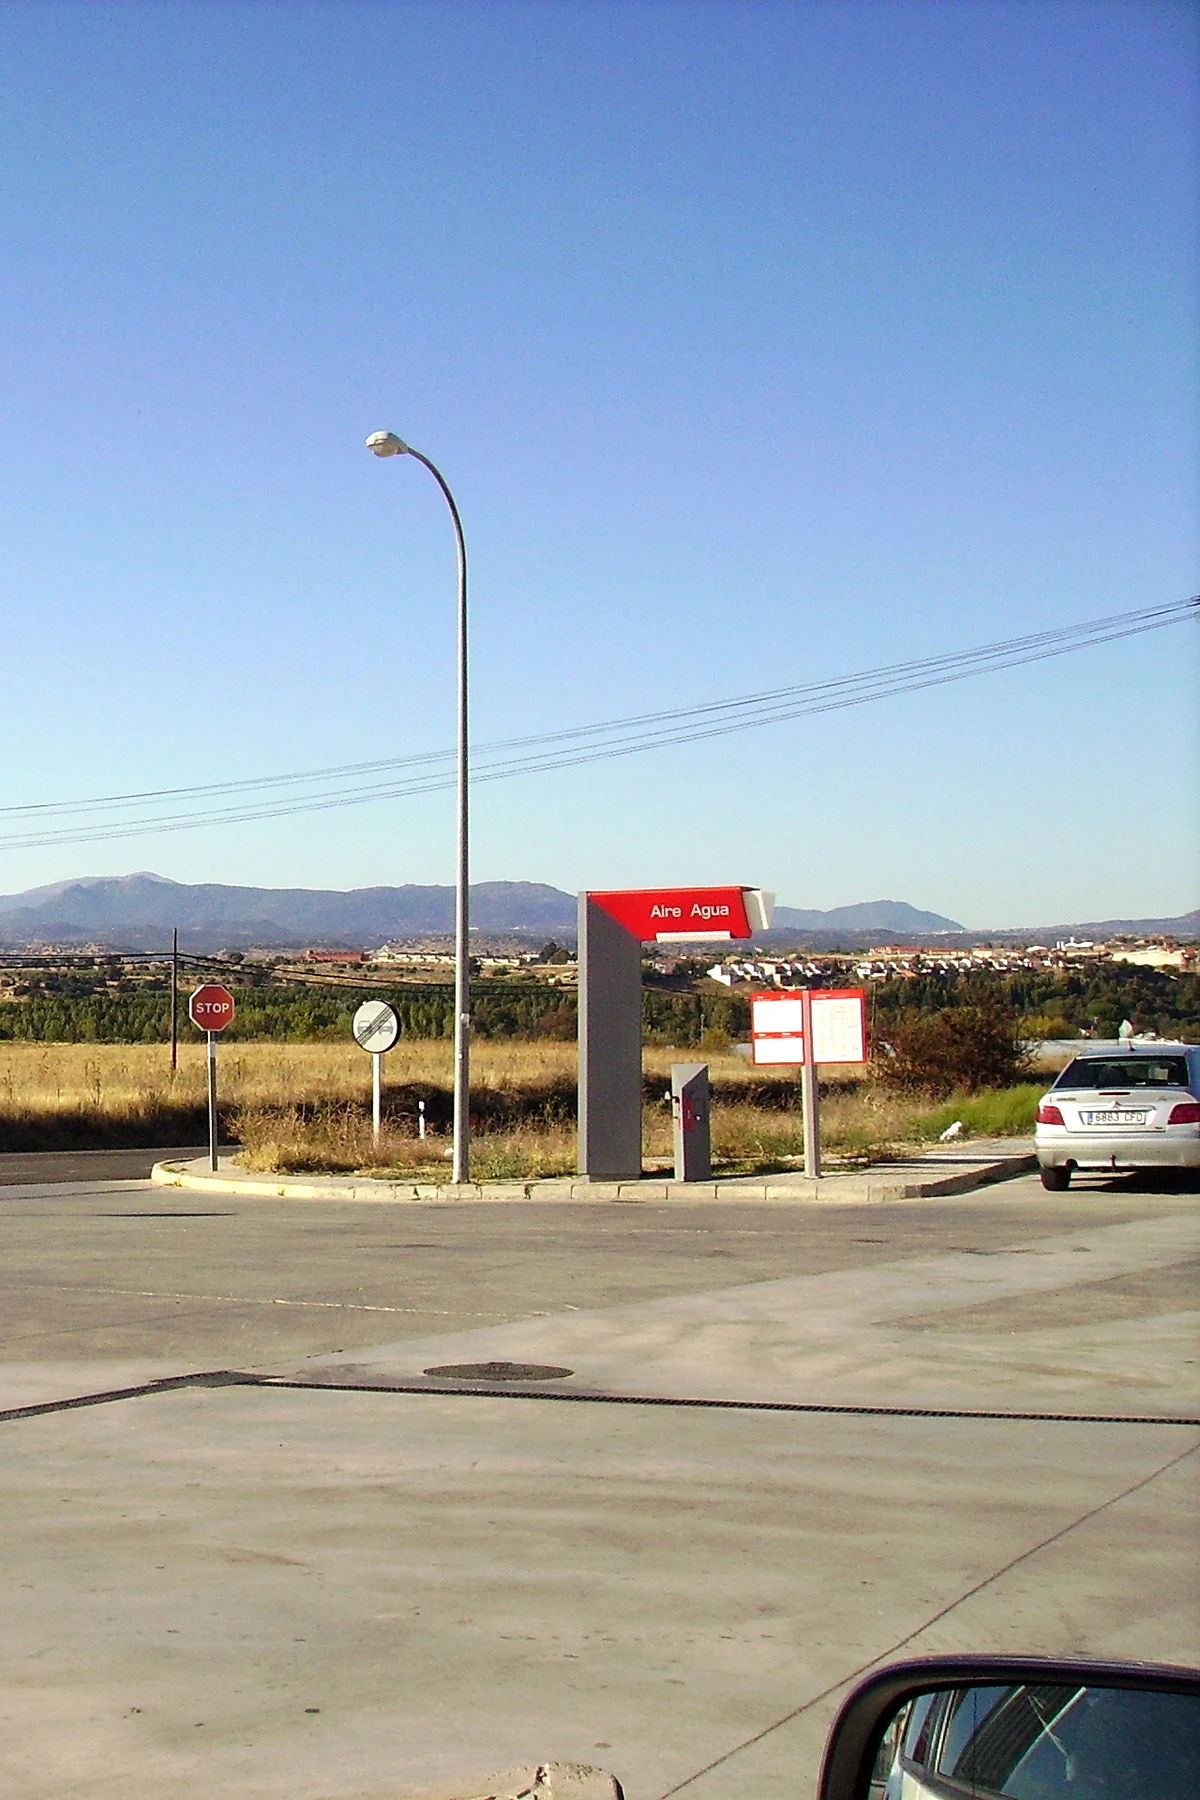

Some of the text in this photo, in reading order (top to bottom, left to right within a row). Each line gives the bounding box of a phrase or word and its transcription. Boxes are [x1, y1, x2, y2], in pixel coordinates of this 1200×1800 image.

[650, 904, 730, 920] Aire Agua
[196, 1002, 229, 1014] STOP
